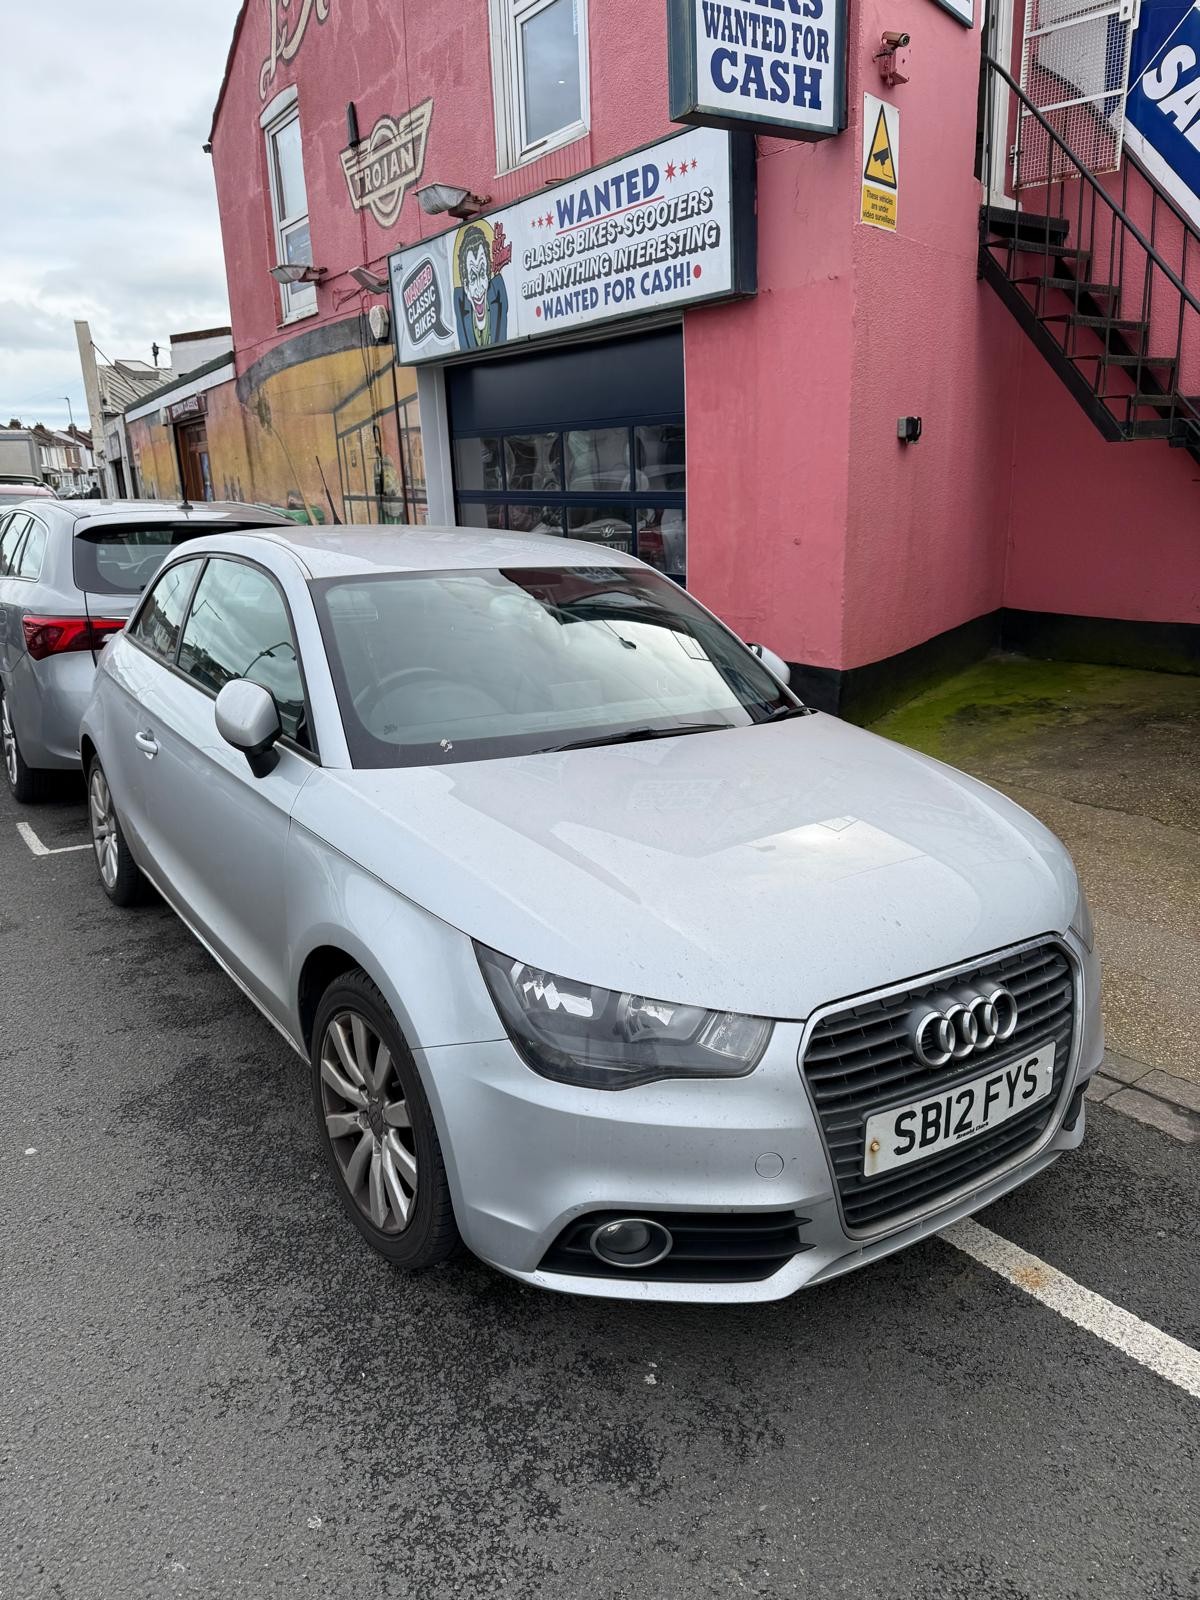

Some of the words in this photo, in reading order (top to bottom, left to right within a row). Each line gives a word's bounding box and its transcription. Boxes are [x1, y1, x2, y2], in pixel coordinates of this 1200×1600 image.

[702, 1, 786, 53] WANTED
[792, 23, 829, 63] FOR
[710, 48, 822, 110] CASH
[1142, 44, 1200, 152] SA
[355, 143, 415, 200] TROJAN
[556, 163, 659, 228] WANTED
[521, 273, 545, 300] and
[545, 254, 612, 291] ANYTHING
[613, 220, 720, 274] INTERESTING
[523, 235, 575, 270] CLASSIC
[404, 264, 432, 308] WANTED
[408, 286, 436, 324] CLASSIC
[543, 288, 598, 321] WANTED
[604, 276, 635, 305] FOR
[640, 261, 691, 296] CASH!
[415, 307, 436, 339] BIKES
[893, 1088, 975, 1156] SB12
[983, 1058, 1039, 1122] FYS
